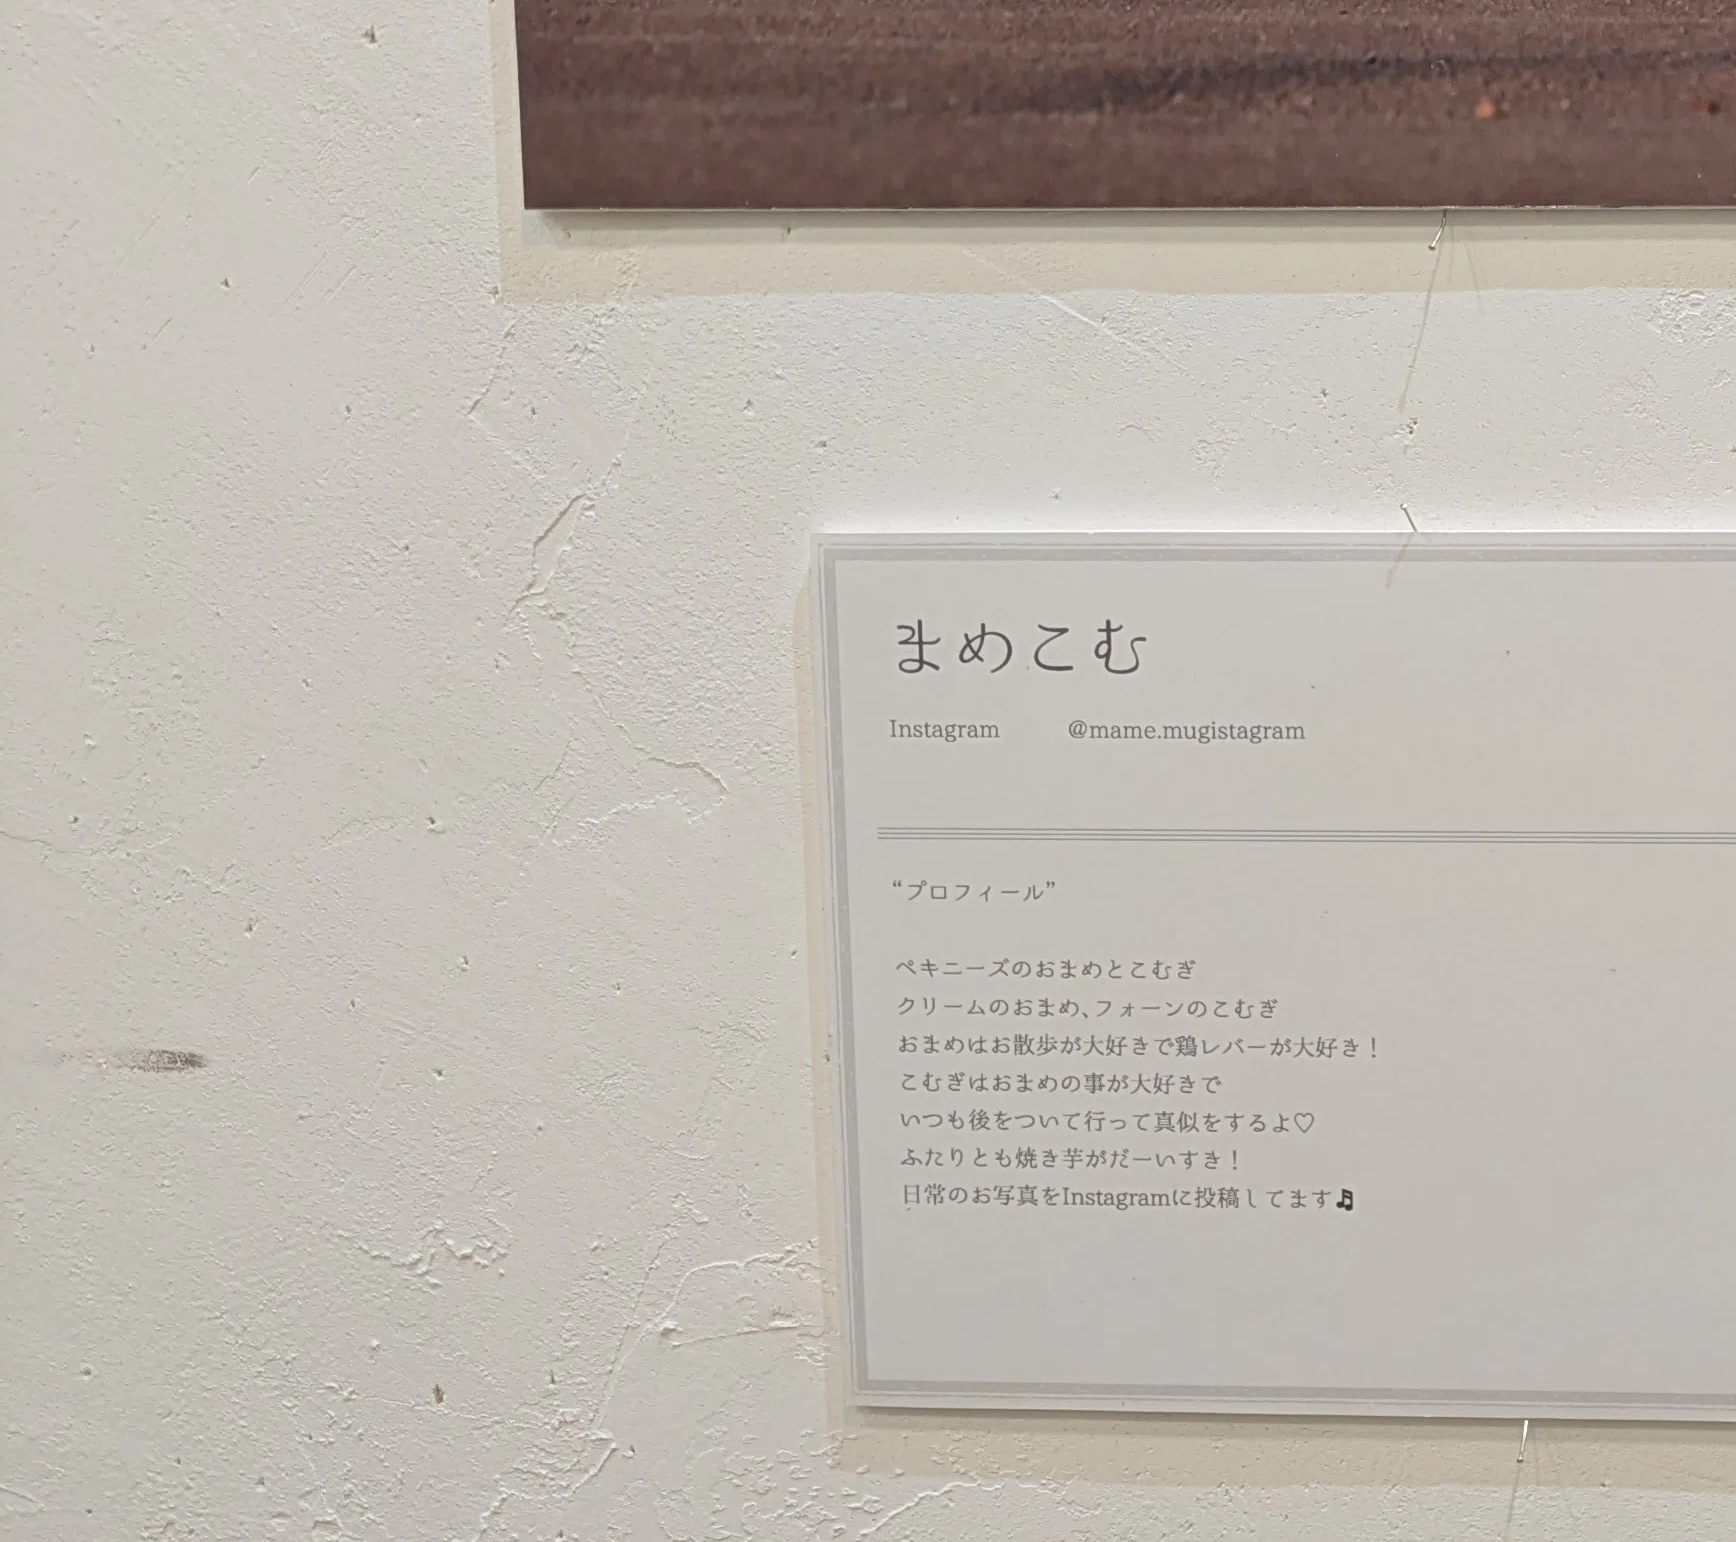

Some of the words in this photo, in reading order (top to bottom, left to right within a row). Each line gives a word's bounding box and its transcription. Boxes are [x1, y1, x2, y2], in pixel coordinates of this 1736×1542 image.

[896, 618, 1148, 675] まめこむ
[888, 718, 1001, 744] Instagram
[1067, 719, 1307, 745] @mame.mugistagram
[895, 957, 1197, 981] ペキニーズのおまめとこむぎ
[896, 996, 1279, 1020] クリームのおまめ、フォーンのこむぎ
[898, 1032, 1379, 1060] おまめはお散歩が大好きで鶏レバーが大好き！
[900, 1070, 1223, 1096] こむぎはおまめの事が大好きで
[900, 1146, 1239, 1171] ふたりとも焼き芋がだーいすき！
